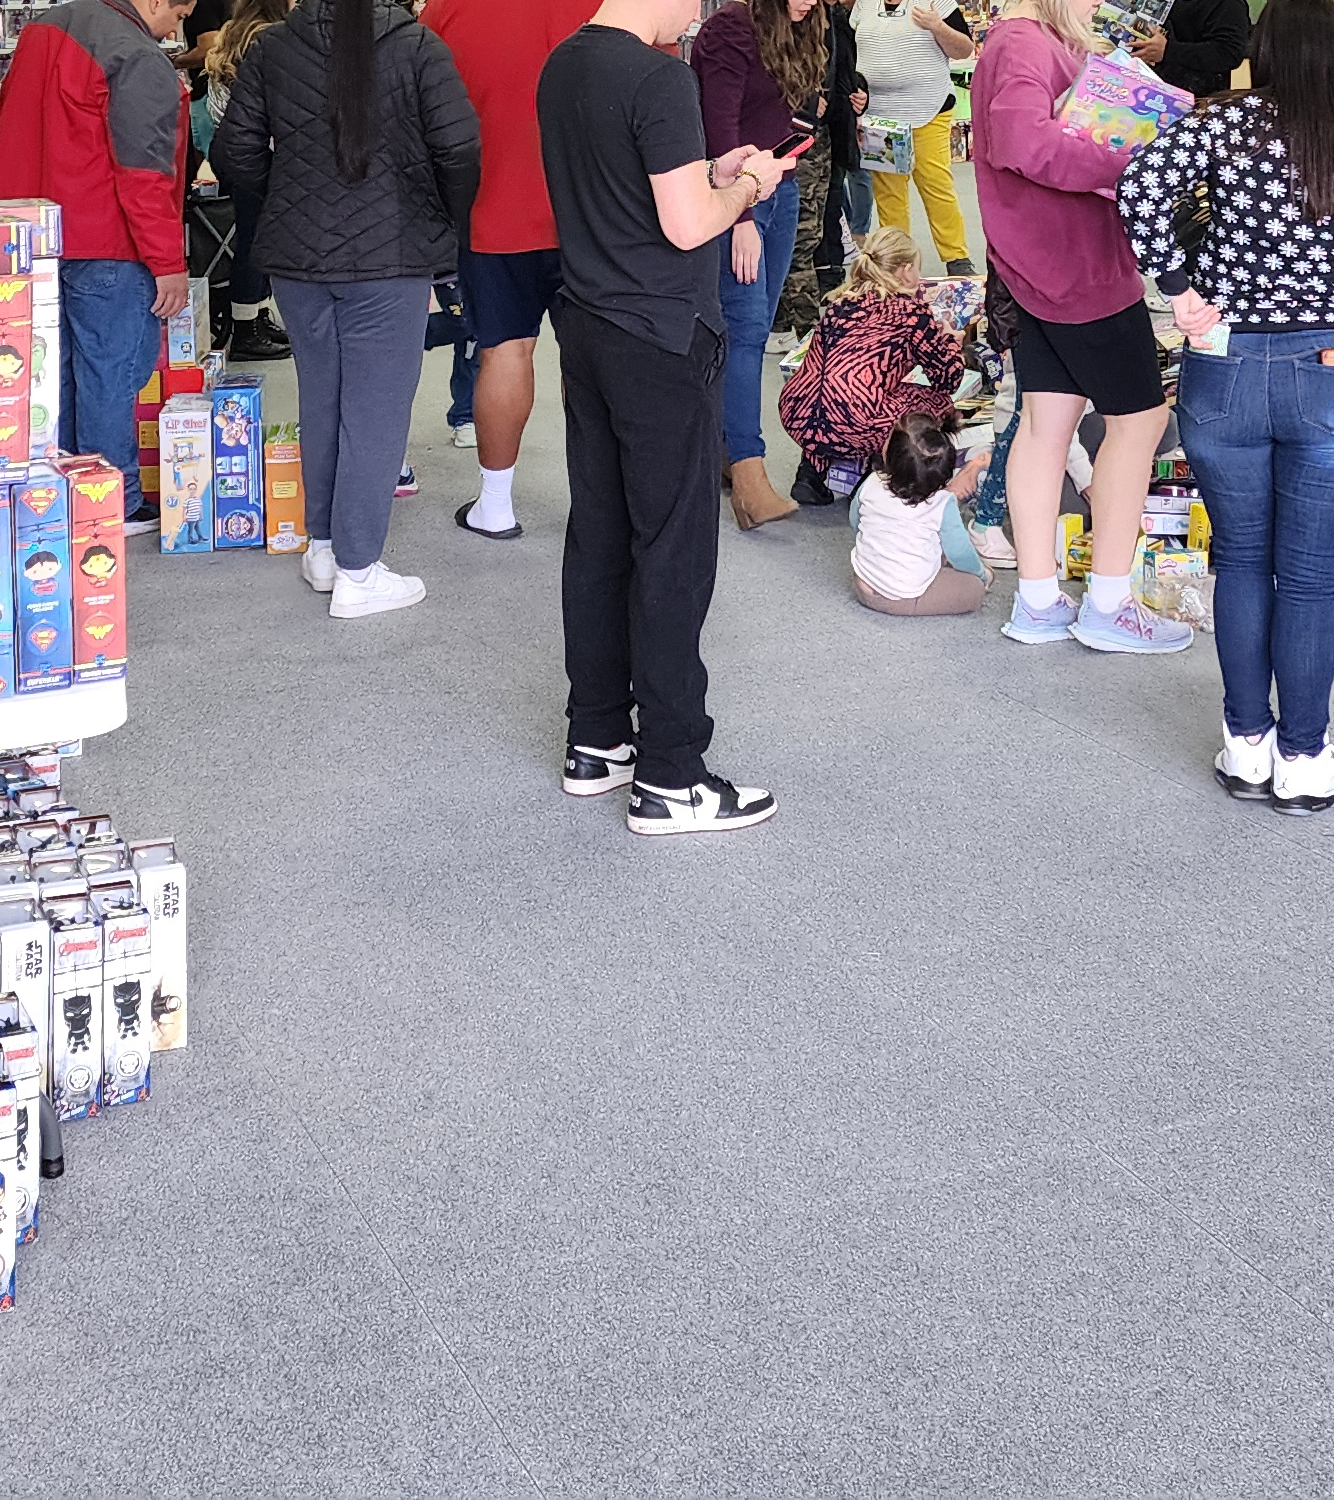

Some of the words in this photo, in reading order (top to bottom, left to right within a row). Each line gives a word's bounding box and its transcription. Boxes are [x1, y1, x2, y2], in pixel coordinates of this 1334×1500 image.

[162, 882, 171, 919] WARS
[170, 882, 179, 918] STAR
[25, 941, 34, 980] WARS
[34, 940, 43, 978] STAR
